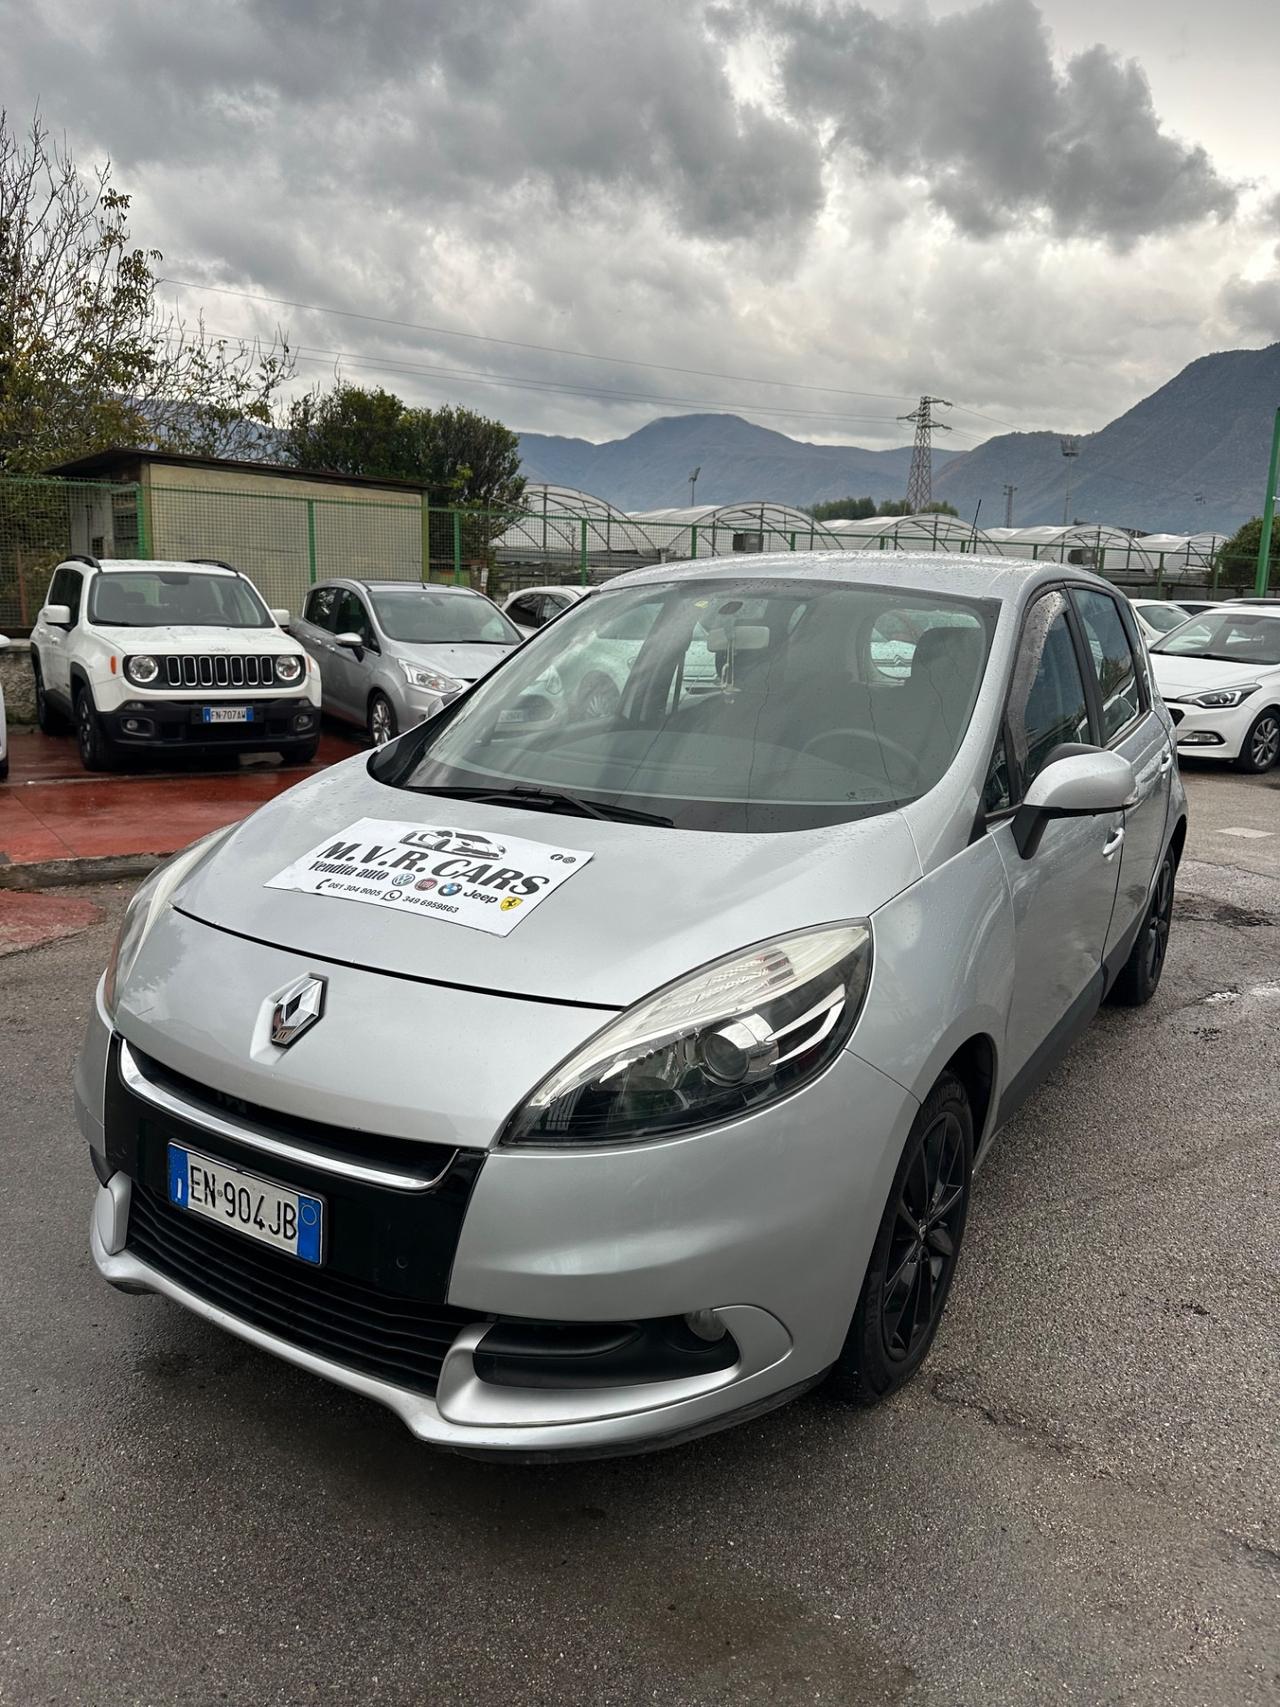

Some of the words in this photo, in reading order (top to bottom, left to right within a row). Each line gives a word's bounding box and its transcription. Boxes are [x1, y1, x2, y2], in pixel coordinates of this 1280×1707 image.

[308, 860, 358, 876] Vendita
[355, 868, 390, 881] auto
[316, 841, 429, 873] M.V.R.
[431, 859, 550, 895] CARS
[344, 884, 360, 892] 304
[360, 888, 383, 896] 8005
[463, 890, 498, 904] Jeep
[402, 896, 421, 904] 349
[420, 900, 460, 914] 6959863
